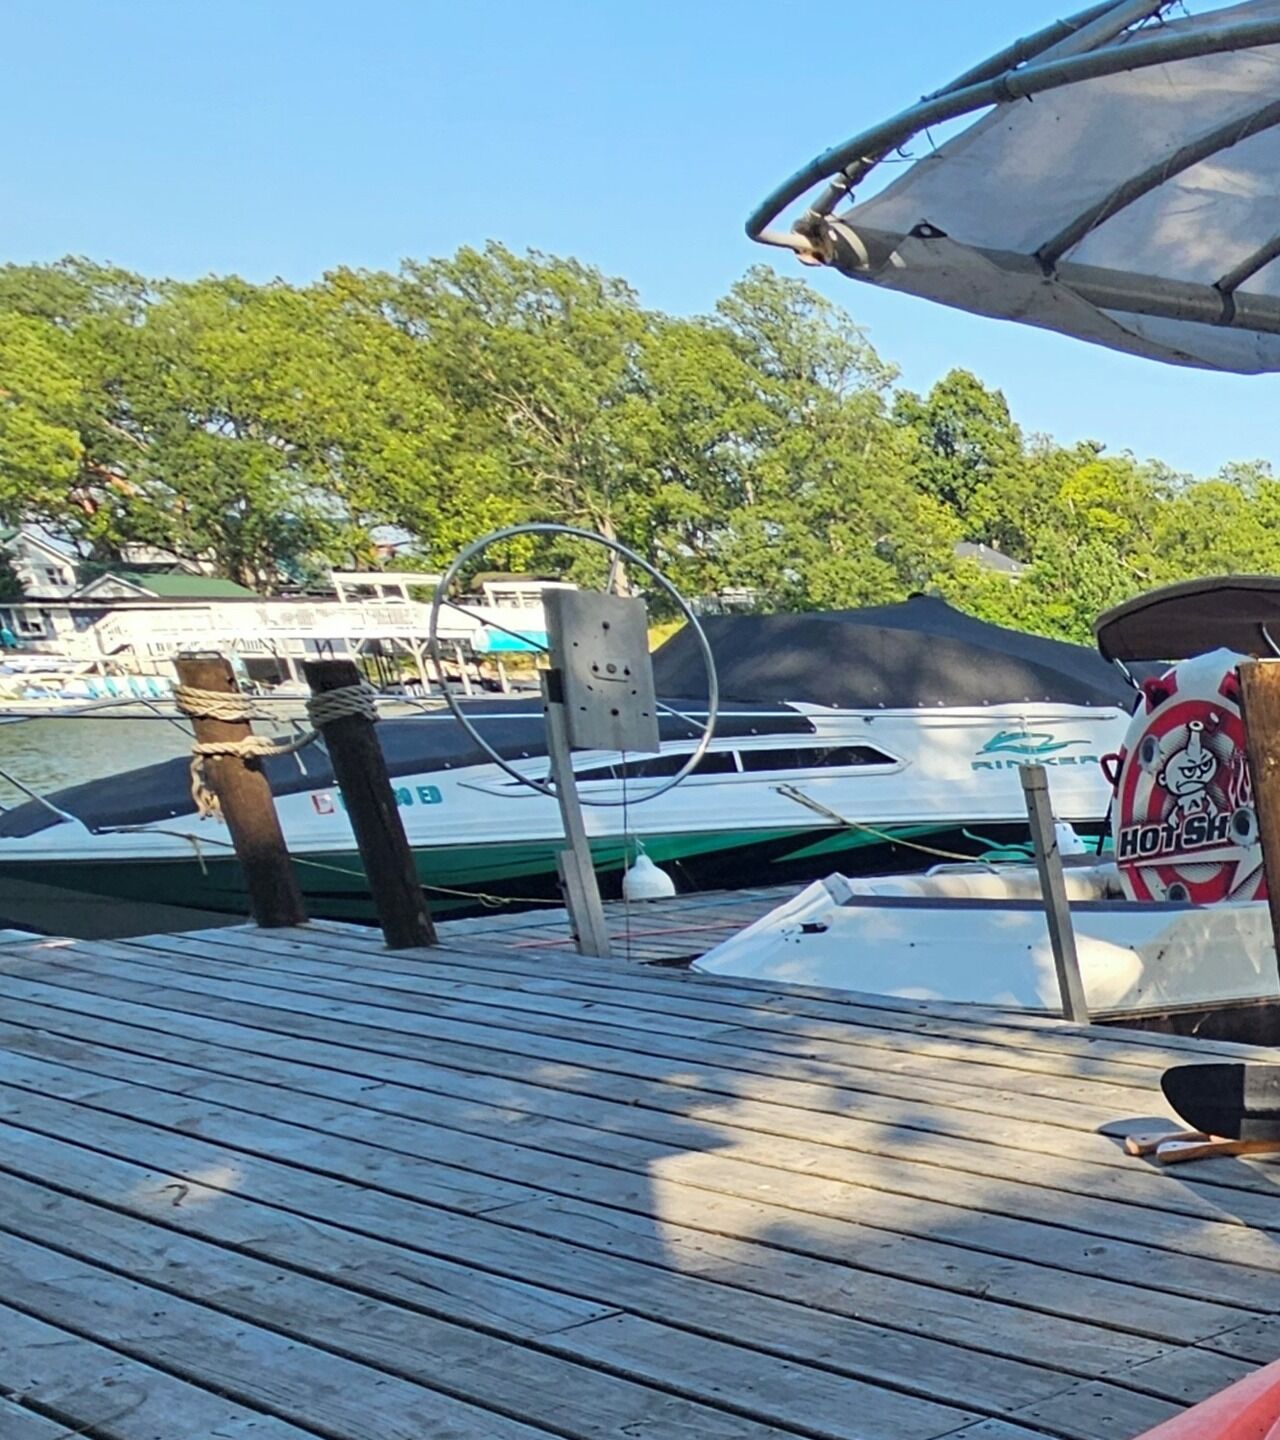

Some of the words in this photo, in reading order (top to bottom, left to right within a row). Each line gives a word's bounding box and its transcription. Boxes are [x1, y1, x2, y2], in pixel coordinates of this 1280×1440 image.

[971, 755, 1100, 771] RINKER
[1118, 821, 1182, 861] HOT
[1181, 812, 1232, 849] SH
